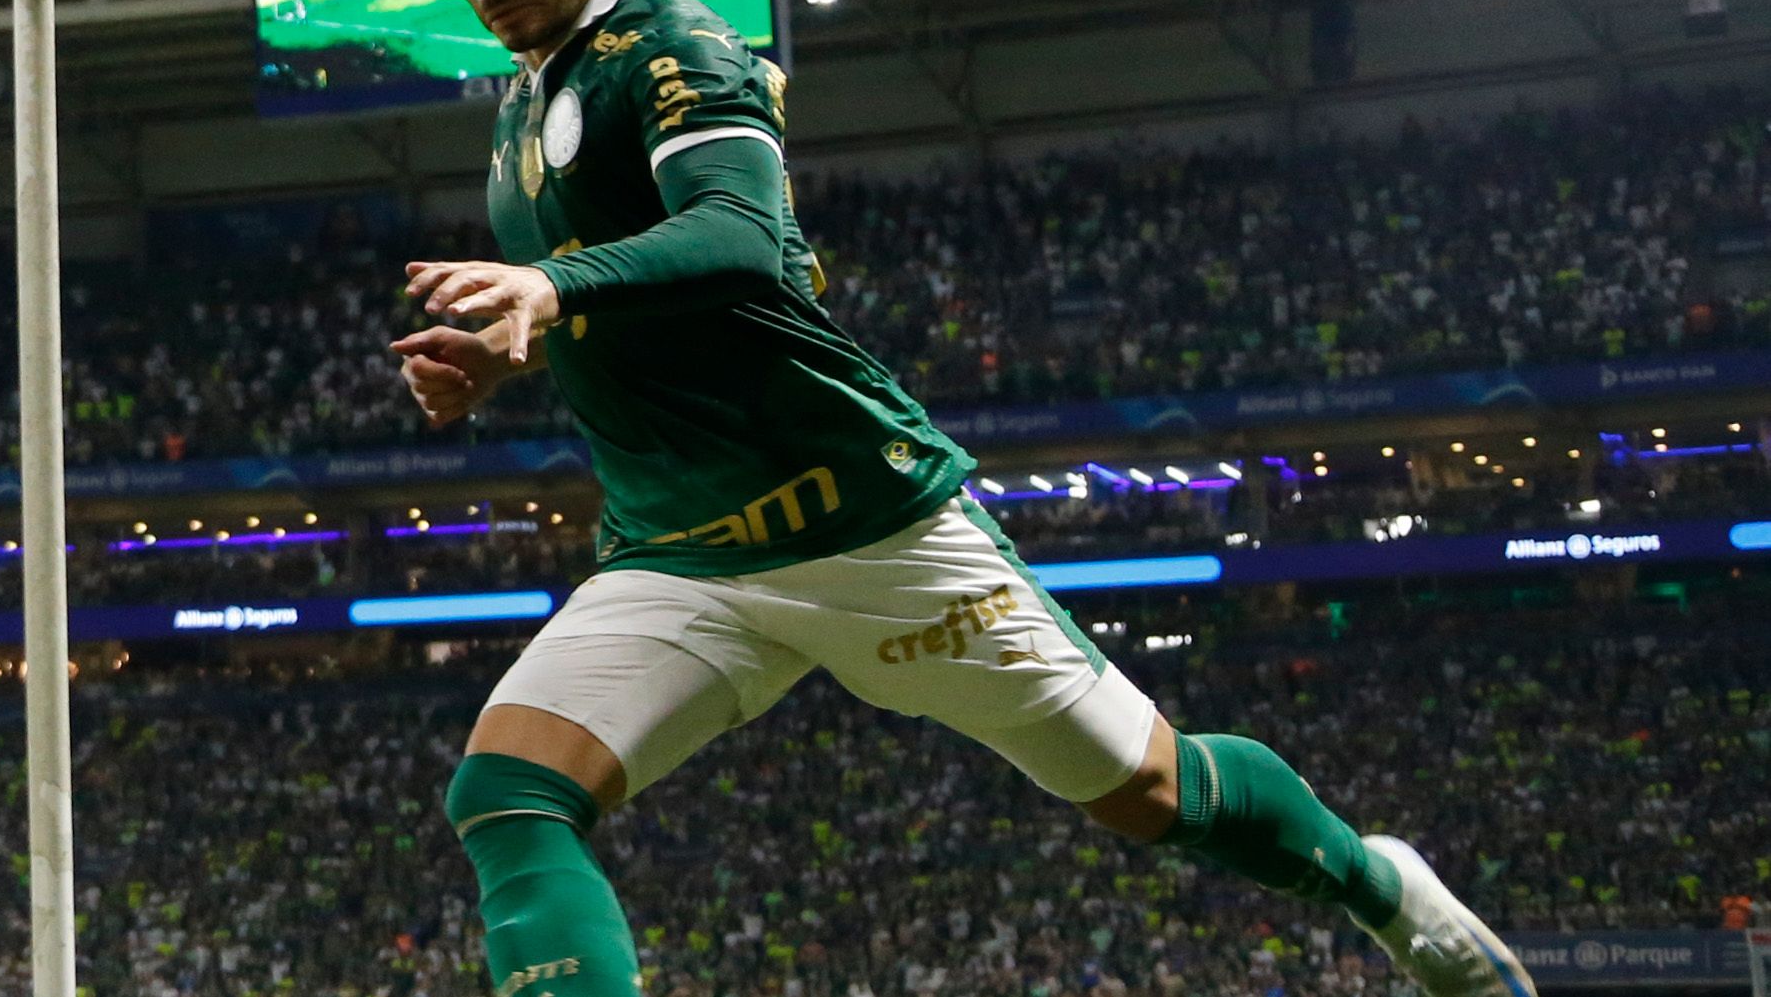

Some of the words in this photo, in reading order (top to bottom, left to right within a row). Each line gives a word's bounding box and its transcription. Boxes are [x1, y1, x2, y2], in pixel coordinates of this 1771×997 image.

[1505, 538, 1566, 559] Allianz
[1592, 534, 1661, 557] Seguros
[173, 609, 225, 629] Allianz
[242, 606, 298, 630] Seguros
[1610, 944, 1694, 970] Parque
